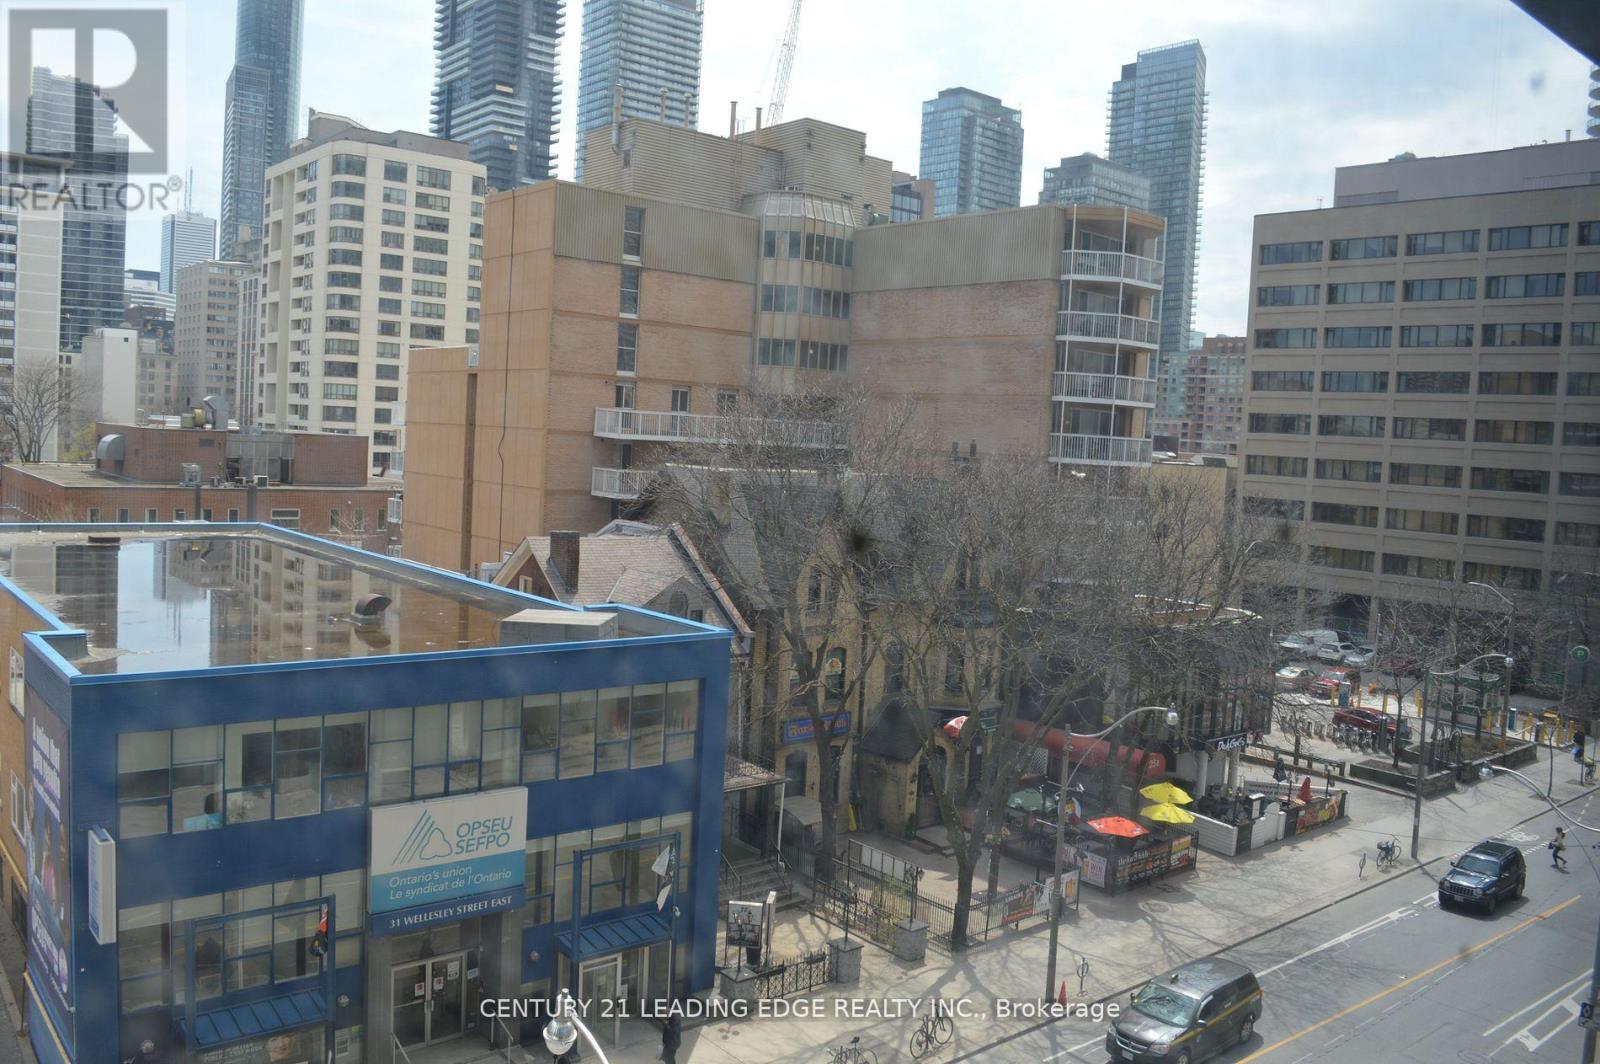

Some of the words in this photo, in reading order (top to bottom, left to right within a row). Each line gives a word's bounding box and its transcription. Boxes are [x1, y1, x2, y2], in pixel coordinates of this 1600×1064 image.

[456, 816, 513, 838] OPSEU
[454, 832, 511, 855] SEFPO
[389, 870, 440, 889] Ontario's
[443, 865, 472, 879] union
[390, 889, 402, 900] Le
[405, 881, 449, 898] syndicat
[452, 877, 465, 889] de
[468, 870, 512, 886] l'Ontario
[389, 919, 401, 929] 31
[404, 907, 454, 925] WELLESLEY
[456, 901, 489, 916] STREET
[491, 896, 512, 908] EAST
